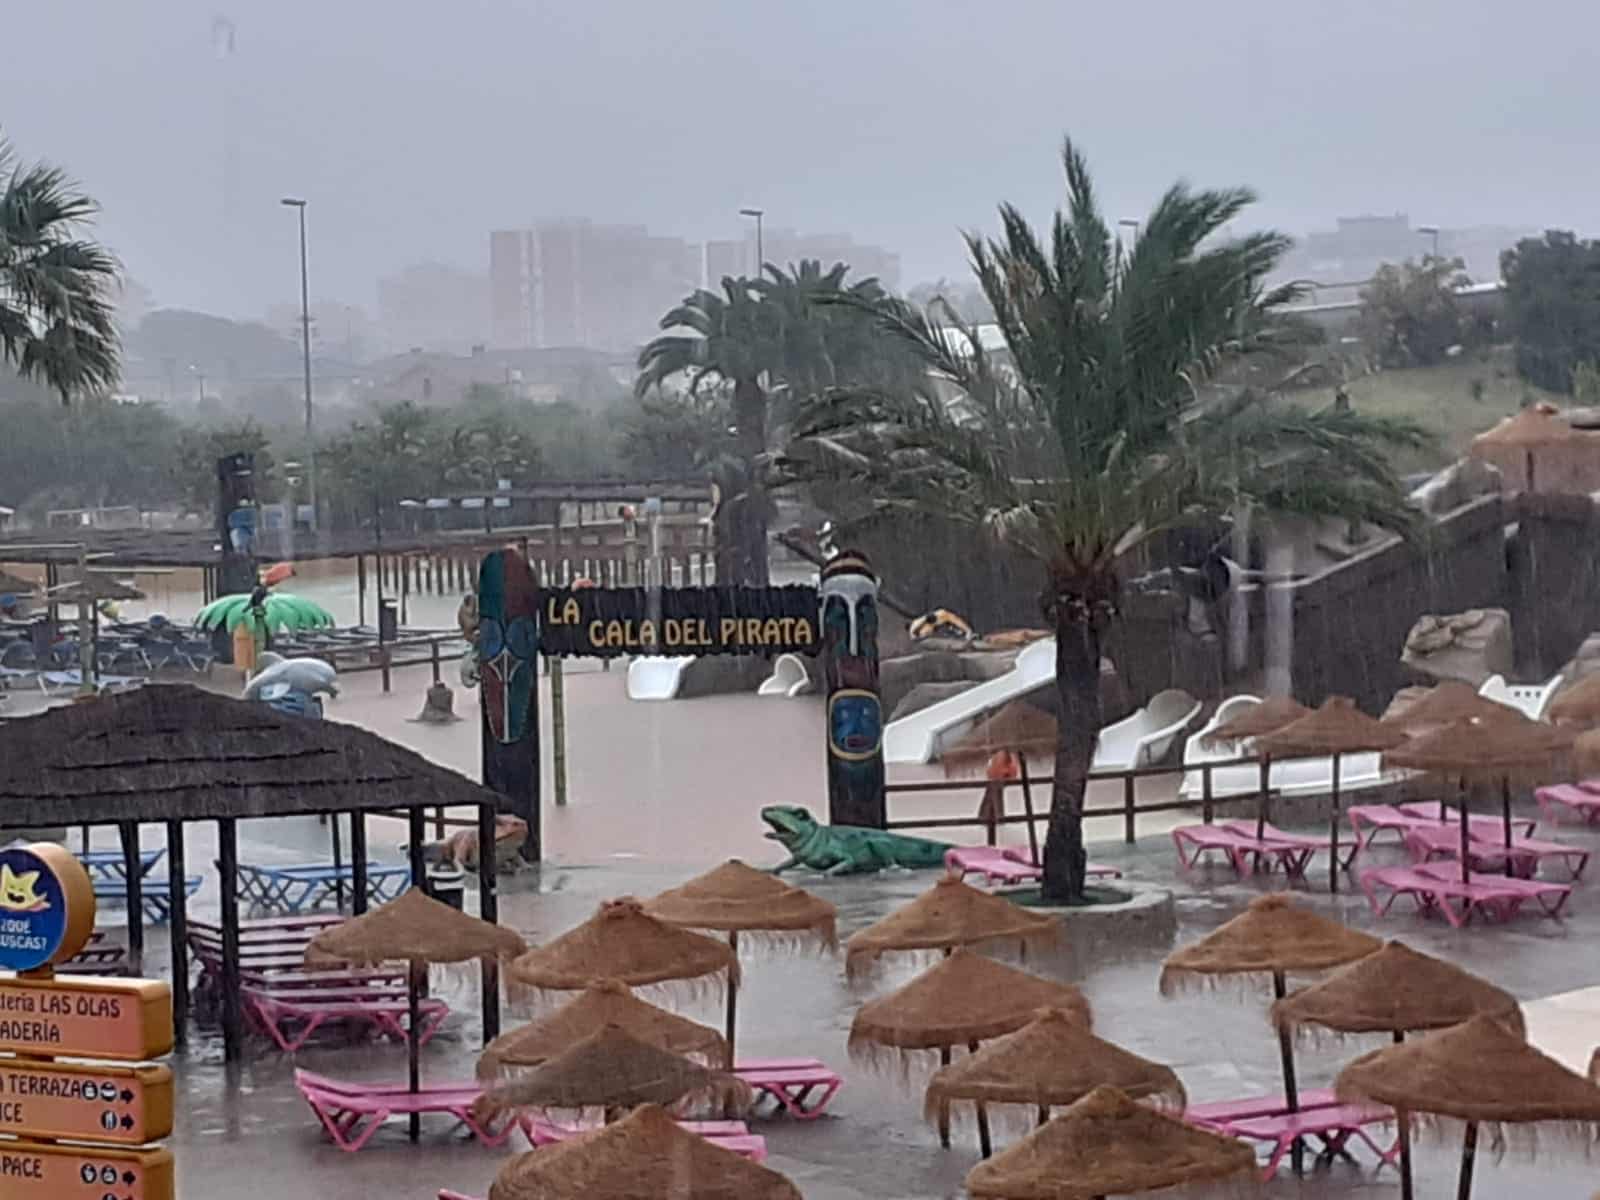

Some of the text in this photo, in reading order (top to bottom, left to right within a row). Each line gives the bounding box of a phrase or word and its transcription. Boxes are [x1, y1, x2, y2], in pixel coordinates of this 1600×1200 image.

[548, 597, 580, 624] LA
[589, 618, 812, 646] CALA DEL PIRATA
[41, 994, 71, 1014] LAS
[77, 996, 120, 1018] OLAS
[8, 1074, 81, 1099] TERRAZA
[0, 1102, 23, 1122] CE
[0, 1155, 42, 1178] PACE
